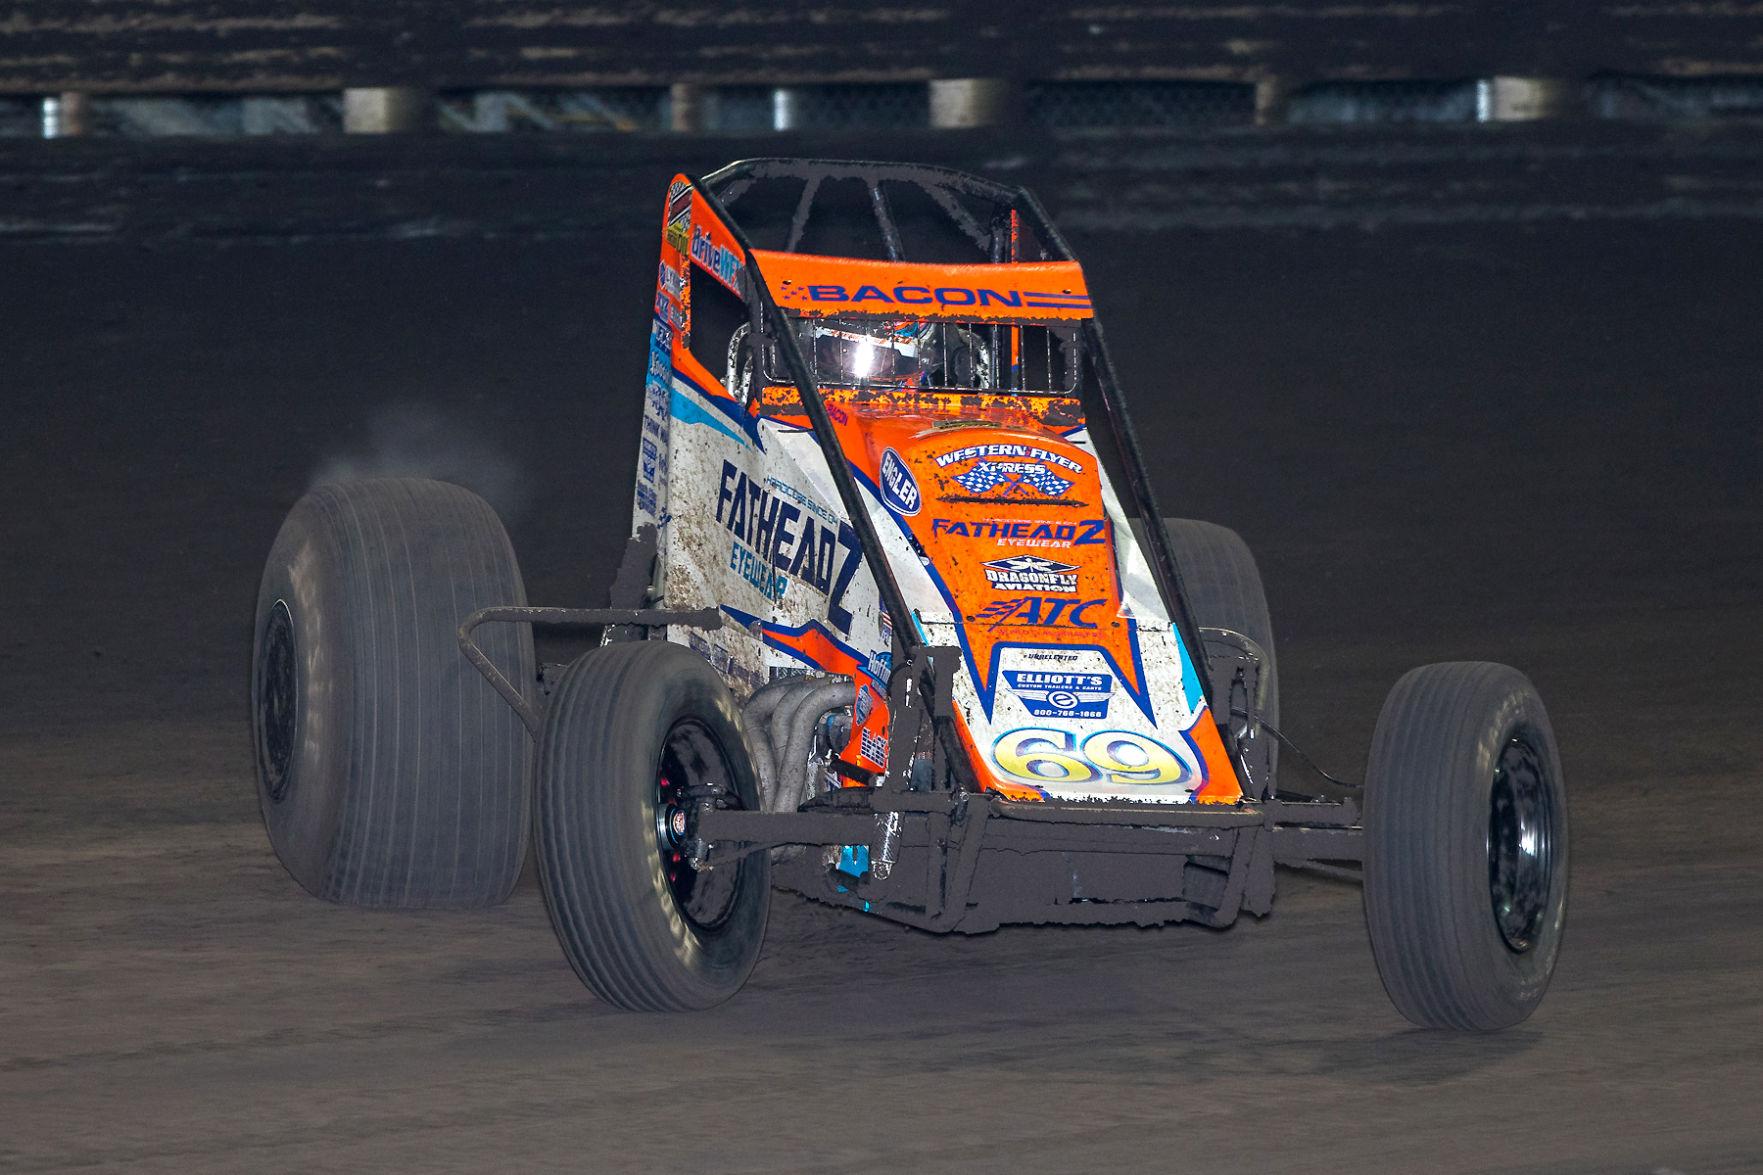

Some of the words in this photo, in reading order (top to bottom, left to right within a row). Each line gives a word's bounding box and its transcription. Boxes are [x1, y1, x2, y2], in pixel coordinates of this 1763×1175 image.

[807, 285, 1023, 308] BACON
[935, 444, 1027, 468] WESTERN
[1030, 445, 1083, 473] FLYER
[881, 453, 918, 510] ENGLER
[932, 518, 1106, 545] FATHEADZ
[996, 538, 1072, 549] EYEWEAR
[716, 459, 863, 636] FATHEADZ
[730, 541, 789, 601] EYEWEAR
[986, 569, 1078, 586] DRAGONFLY
[994, 583, 1077, 593] AVIATION
[988, 596, 1108, 632] ATC
[1017, 673, 1103, 686] ELLIOTT'S
[991, 727, 1193, 786] 69
